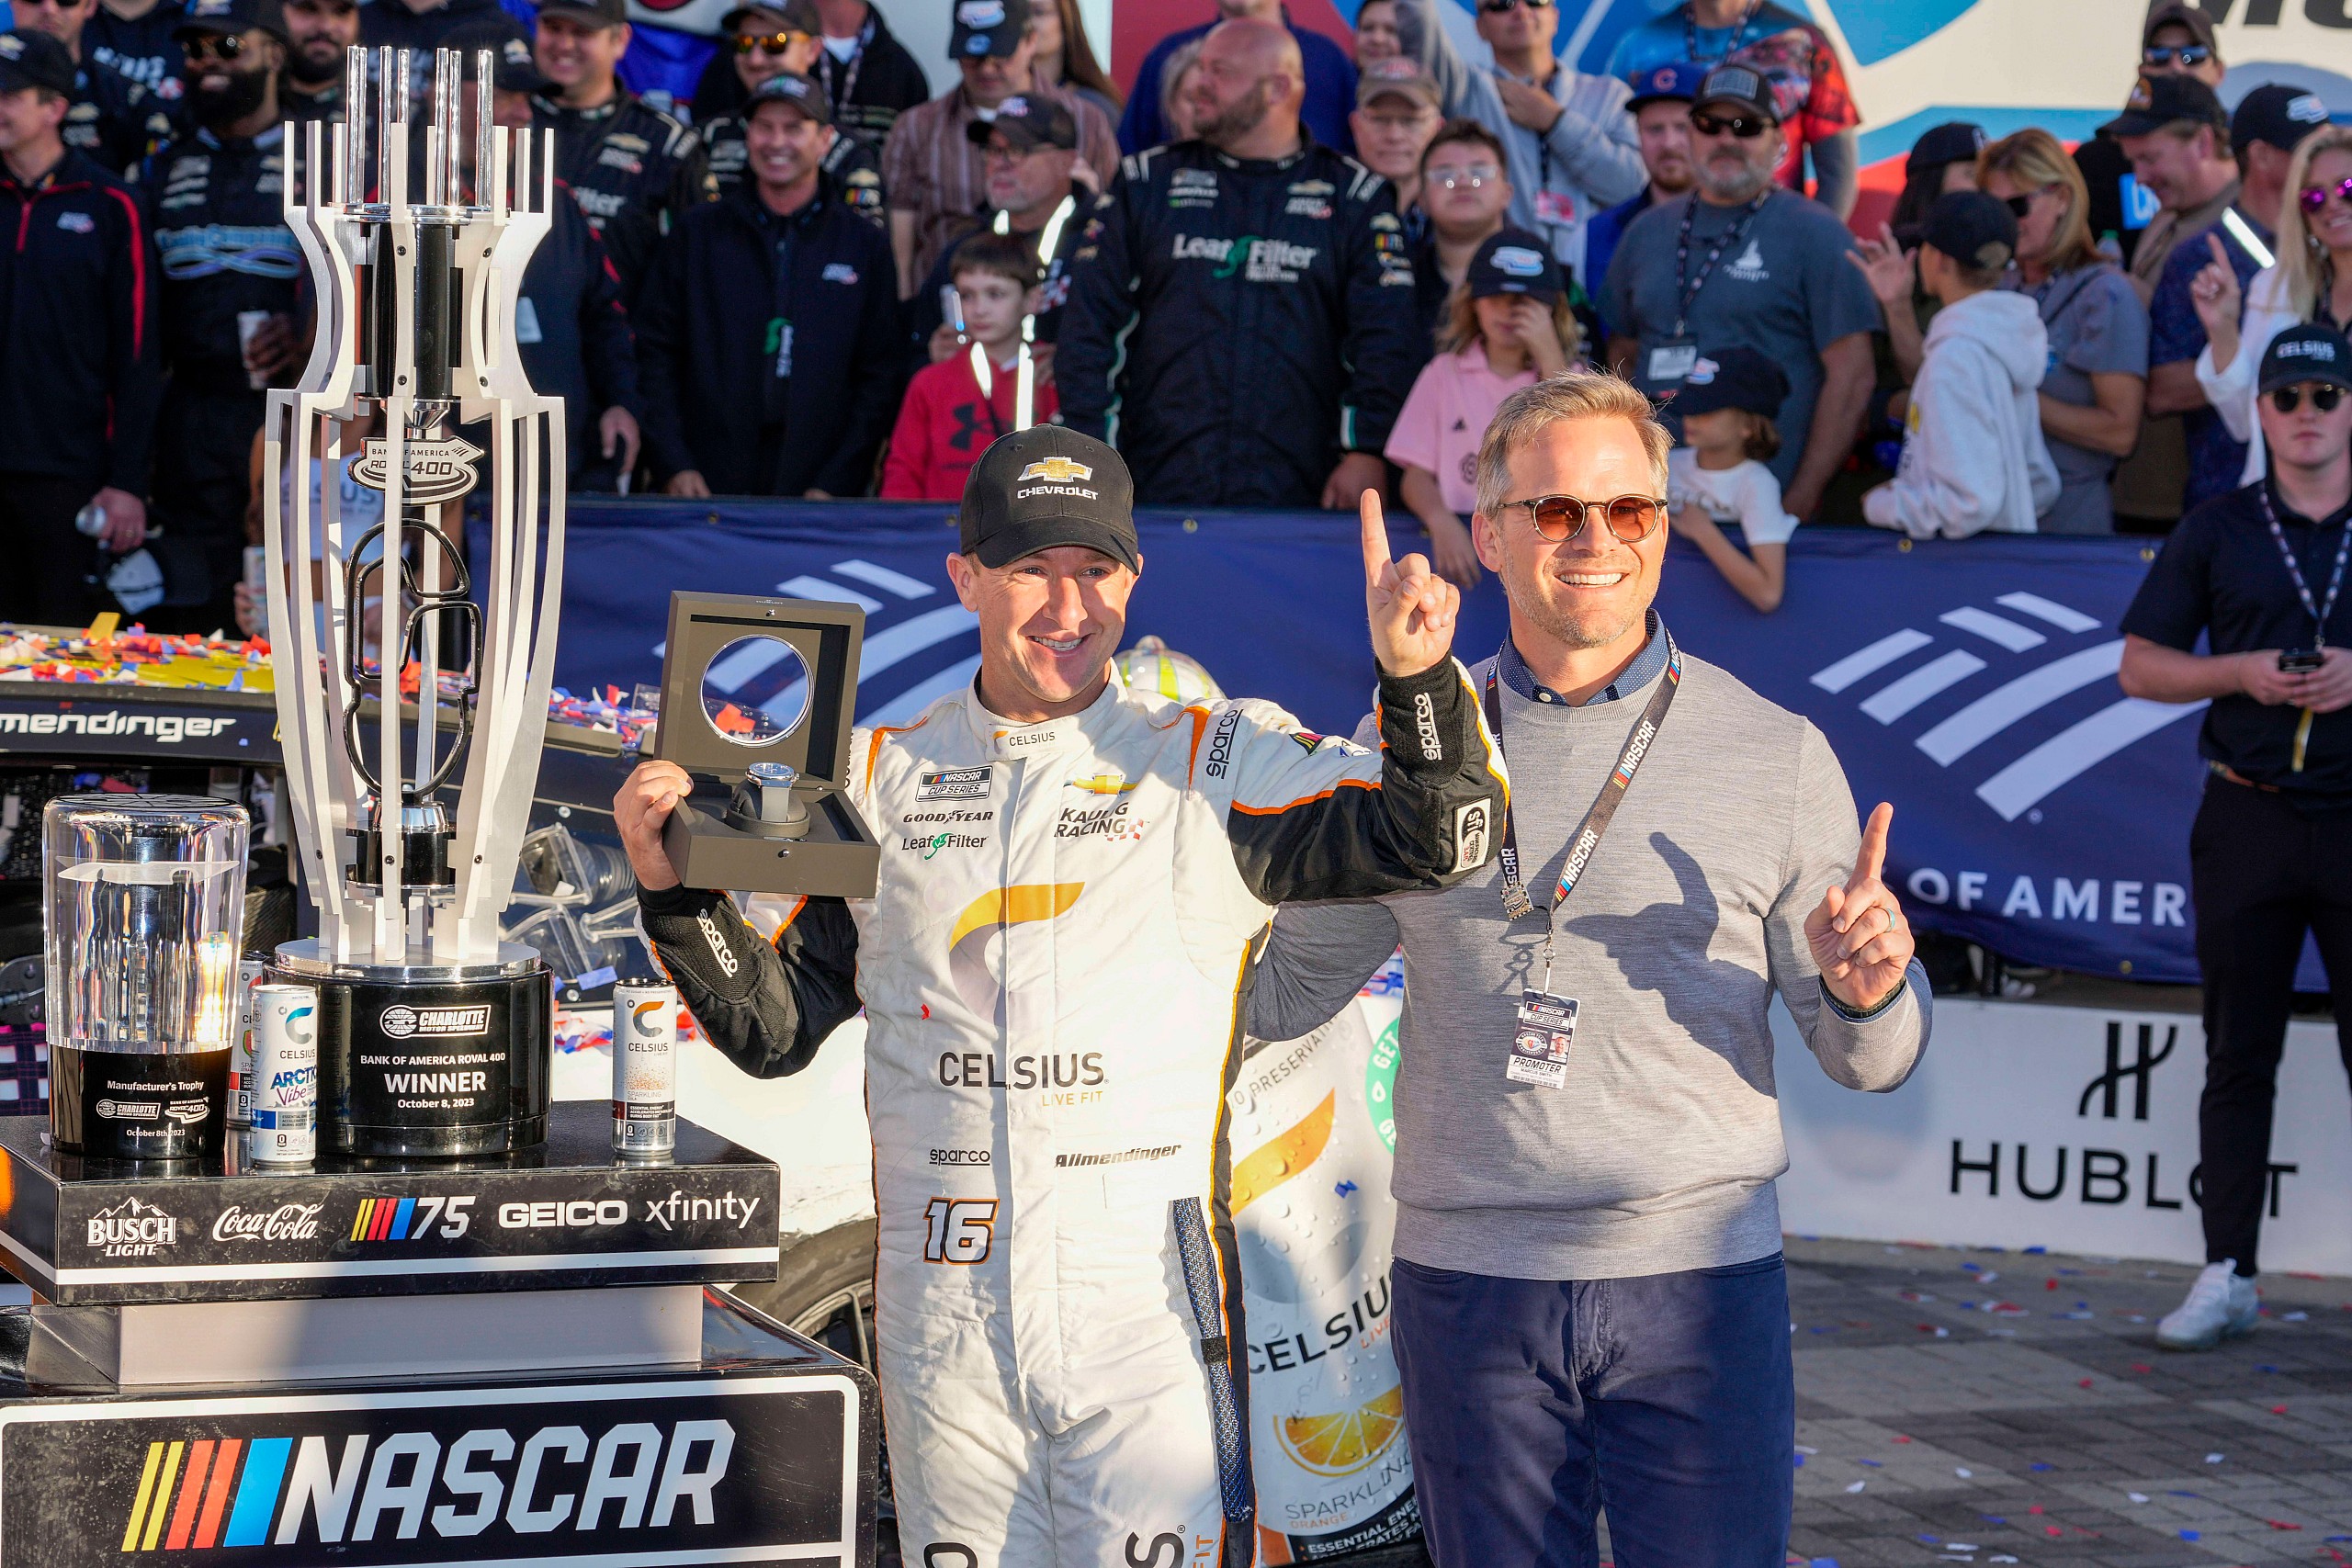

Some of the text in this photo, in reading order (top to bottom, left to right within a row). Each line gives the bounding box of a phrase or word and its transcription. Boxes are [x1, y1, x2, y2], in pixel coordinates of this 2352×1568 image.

[2277, 340, 2335, 359] CELSIUS
[370, 460, 453, 476] ROL 400
[1017, 485, 1099, 501] CHEVROLET
[1415, 692, 1442, 761] sparco
[1009, 731, 1057, 747] CELSIUS
[1206, 708, 1244, 780] sparco
[1622, 718, 1657, 773] NASCAR
[944, 771, 982, 783] NASCAR
[928, 784, 981, 795] CUP SERIES
[1054, 818, 1126, 838] RACING
[1501, 847, 1519, 886] SCAR
[1562, 826, 1600, 888] NASCAR
[1907, 867, 2187, 927] OF AMER
[696, 908, 739, 978] sparco
[419, 1010, 486, 1026] CHARLOTTE
[1530, 1013, 1564, 1025] CUP SERIES
[1541, 1006, 1566, 1017] NASCAR
[419, 1023, 484, 1032] MOTOR SPEEDWAY
[628, 1042, 669, 1053] CELSIUS
[1250, 1015, 1339, 1099] PRESERVATI
[360, 1052, 506, 1066] BANK OF AMERICA ROVAL 400
[1513, 1056, 1562, 1074] PROMOTER
[939, 1051, 1103, 1091] CELSIUS
[107, 1079, 205, 1092] Manufacturer's Trophy
[384, 1071, 487, 1094] WINNER
[276, 1085, 307, 1107] Vibe
[397, 1098, 475, 1109] October 8, 2023
[1042, 1090, 1103, 1107] LIVE FIT
[117, 1103, 157, 1114] CHARLOTTE
[187, 1104, 204, 1112] 400
[126, 1129, 155, 1137] October
[156, 1129, 168, 1137] 8th
[929, 1148, 991, 1167] sparco
[1054, 1143, 1182, 1168] Allmendinger
[410, 1195, 476, 1240] 75
[498, 1200, 628, 1229] GEICO
[644, 1190, 761, 1232] xfinity
[86, 1215, 177, 1247] BUSCH
[212, 1202, 325, 1243] Coca-Cola
[922, 1196, 1000, 1266] 16
[103, 1244, 157, 1258] LIGHT
[1248, 1266, 1392, 1374] CELSIU
[274, 1418, 737, 1546] NASCAR
[1290, 1512, 1349, 1529] ORANGE
[1308, 1524, 1388, 1554] ESSENTIAL
